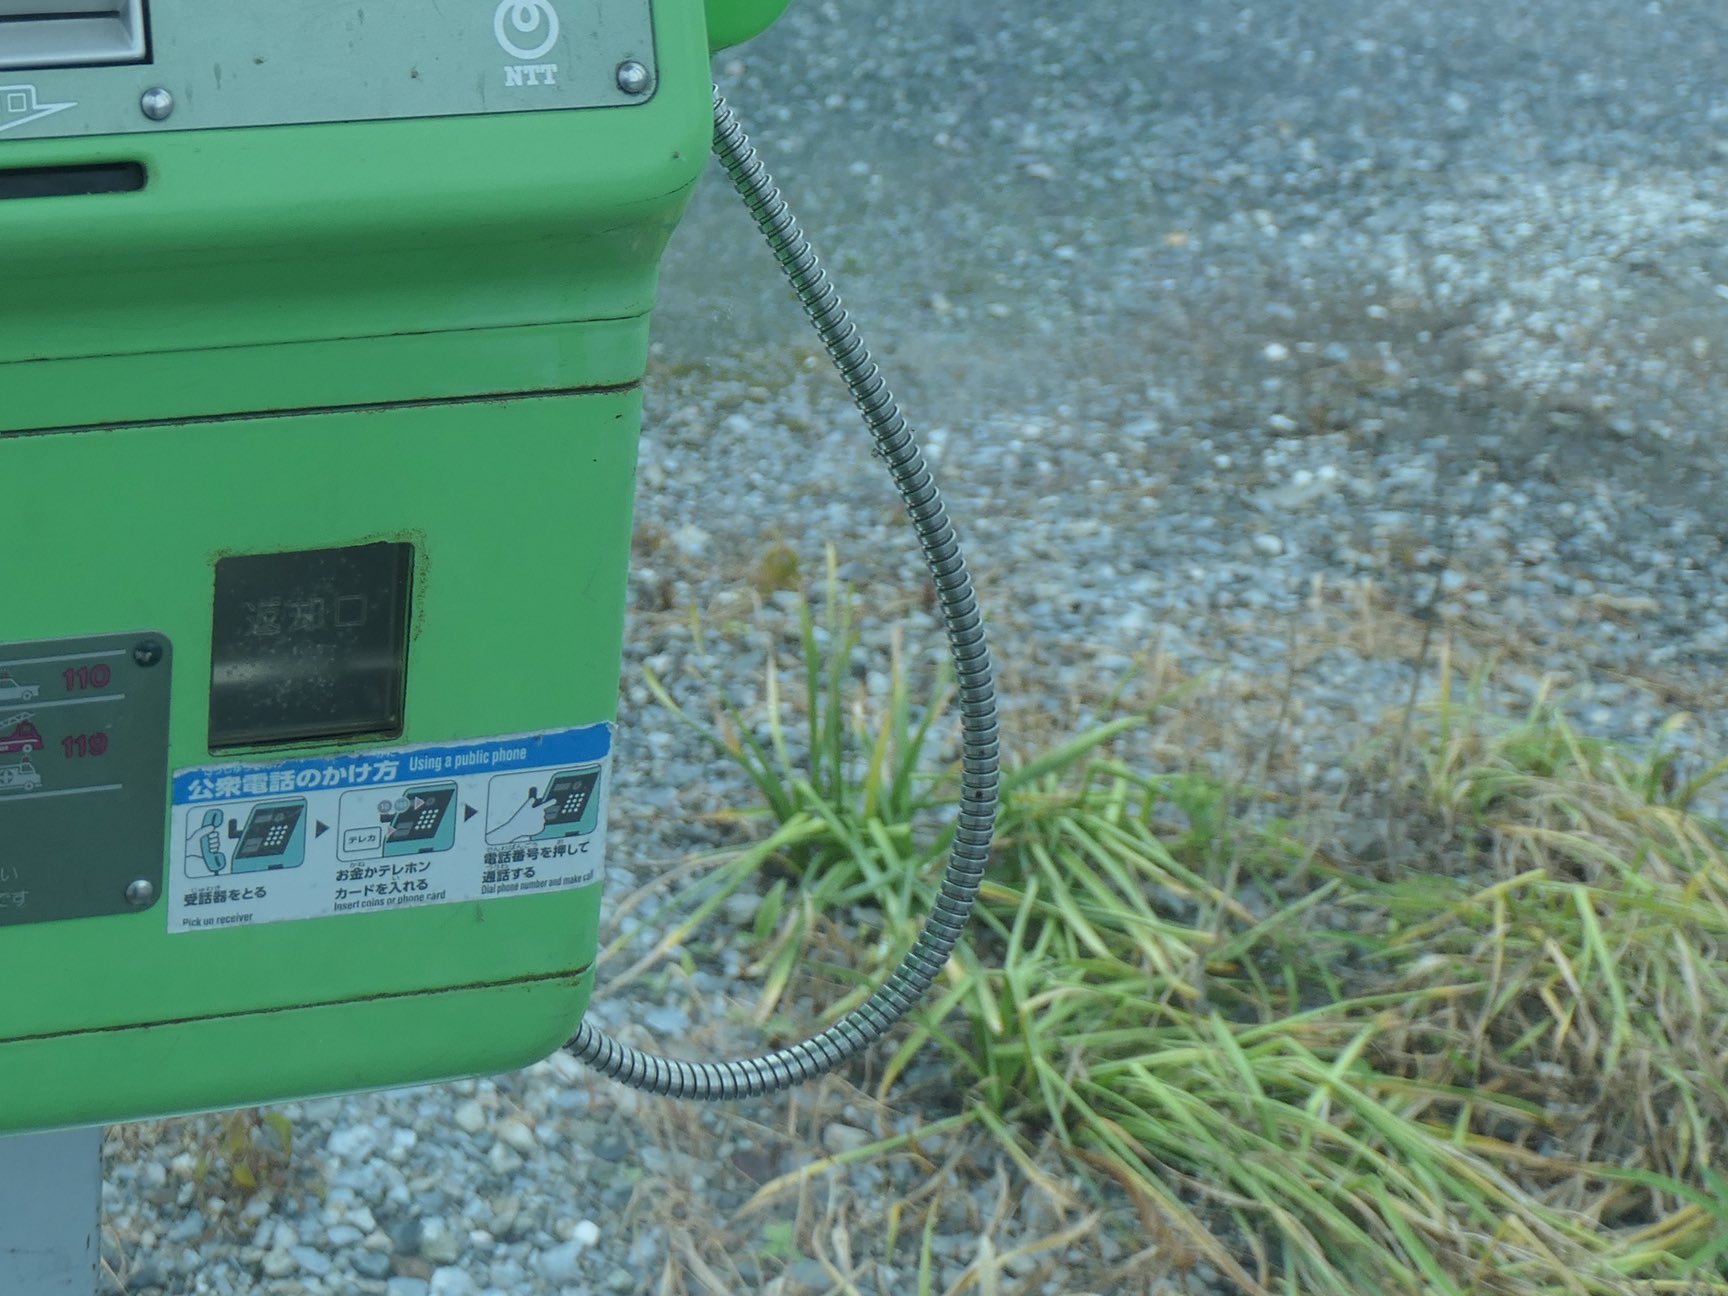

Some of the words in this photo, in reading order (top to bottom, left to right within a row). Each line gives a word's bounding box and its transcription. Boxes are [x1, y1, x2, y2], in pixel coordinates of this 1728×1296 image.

[503, 63, 558, 87] NTT
[63, 663, 111, 692] 110
[62, 731, 109, 759] 119
[408, 755, 442, 772] Using
[444, 756, 452, 768] a
[454, 749, 490, 770] public
[491, 746, 527, 766] phone
[187, 759, 400, 801] 公衆電話のかけ方
[347, 833, 376, 844] テレカ
[183, 885, 267, 907] 受話器をとる
[216, 912, 254, 925] receiver
